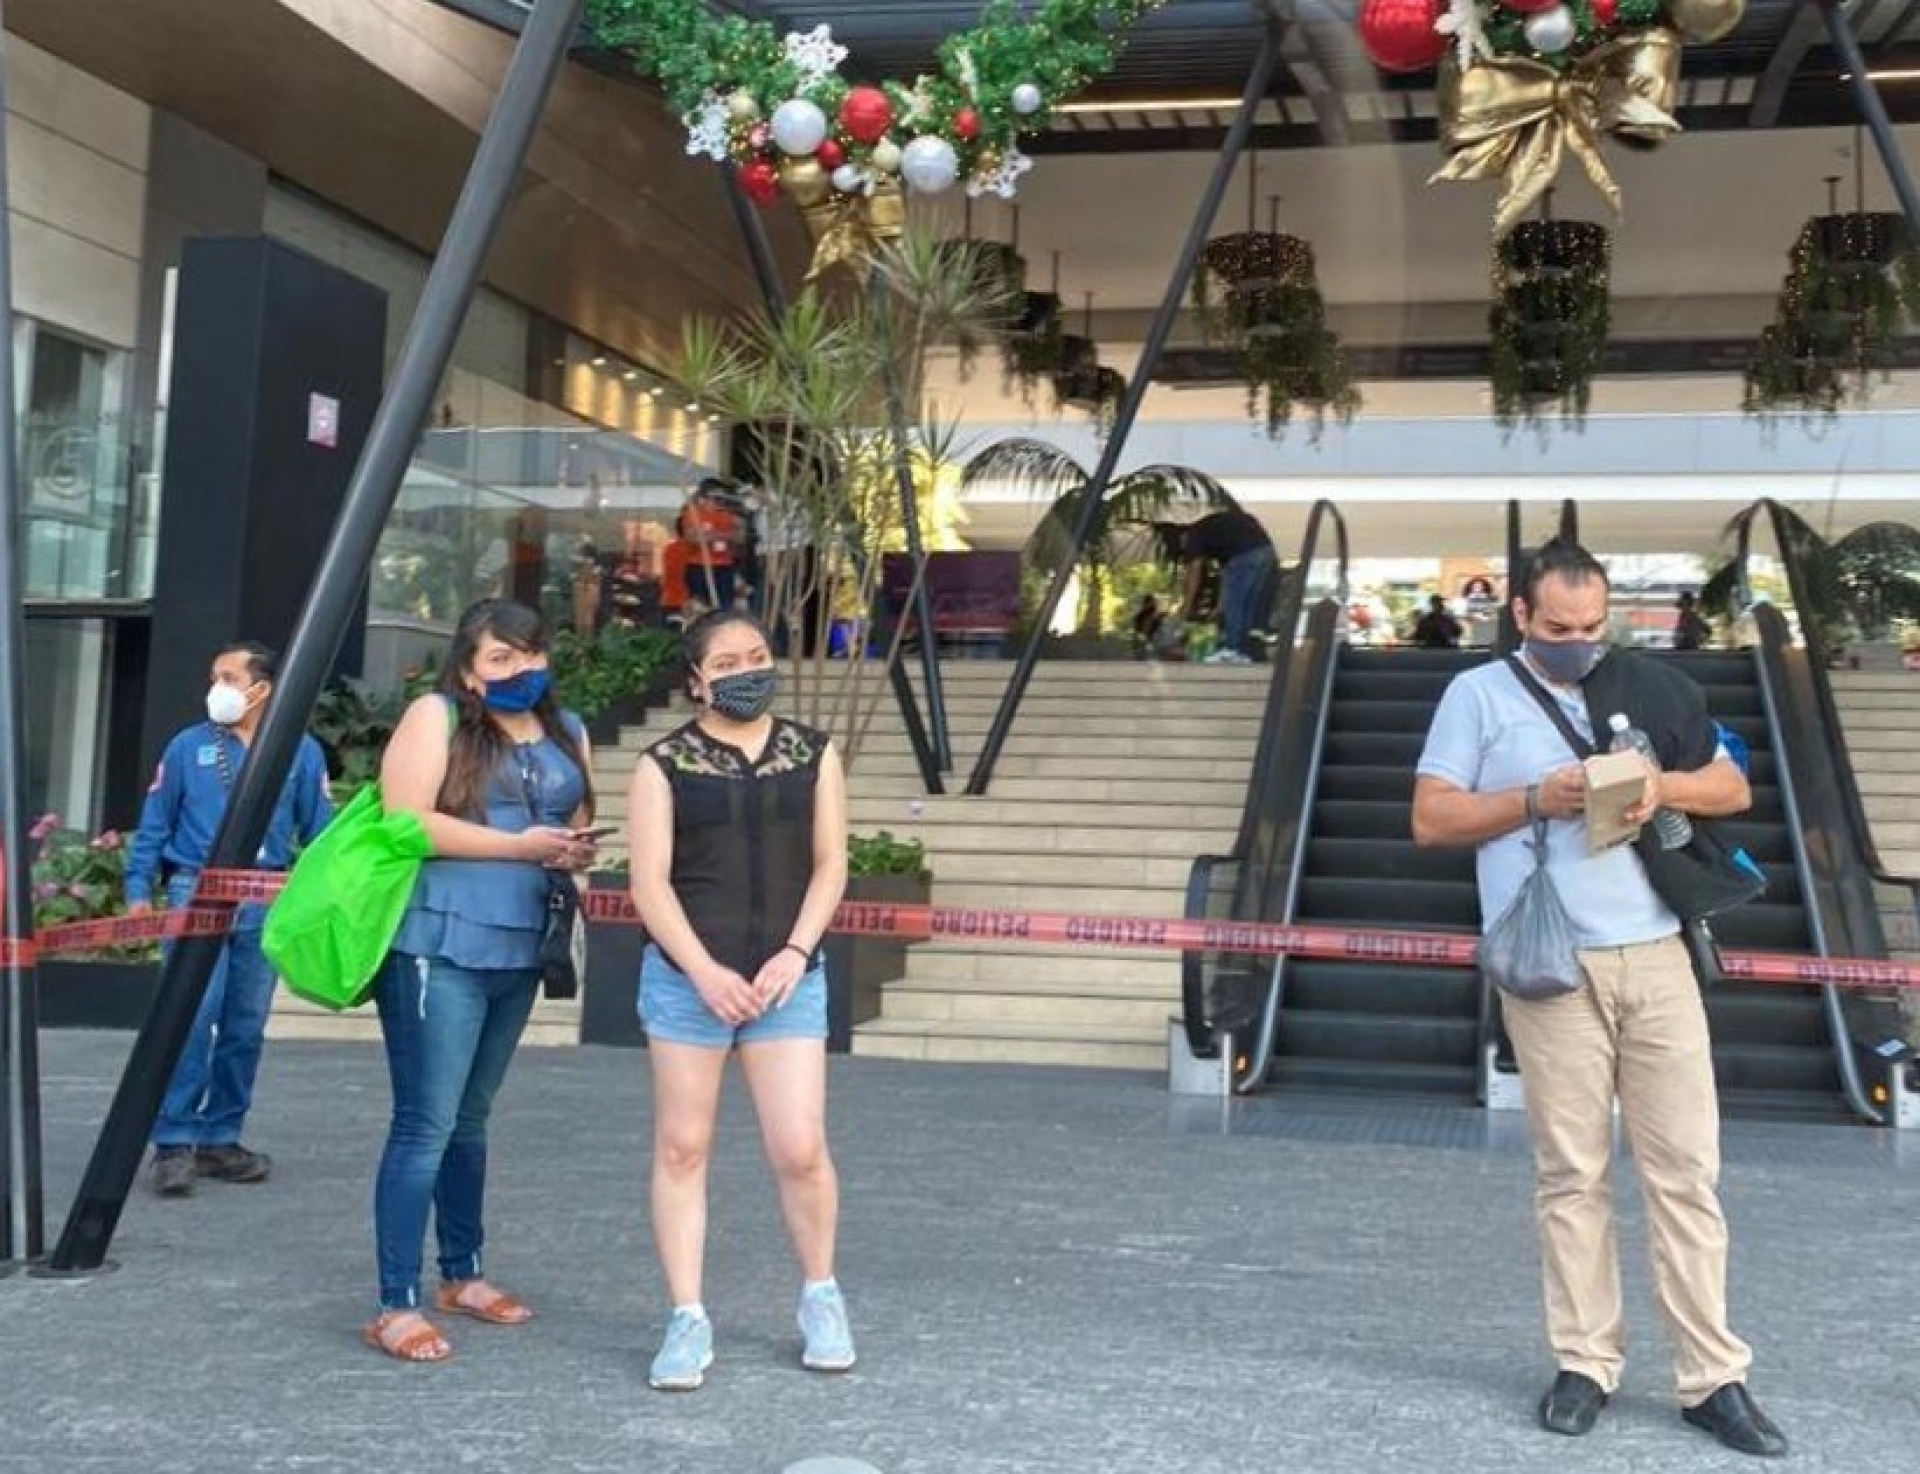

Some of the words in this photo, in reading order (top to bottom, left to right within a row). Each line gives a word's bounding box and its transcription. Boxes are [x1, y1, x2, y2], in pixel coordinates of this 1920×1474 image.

[580, 893, 635, 919] PELI
[931, 910, 1031, 937] PELIGRO
[1065, 916, 1167, 944] PELIGRO
